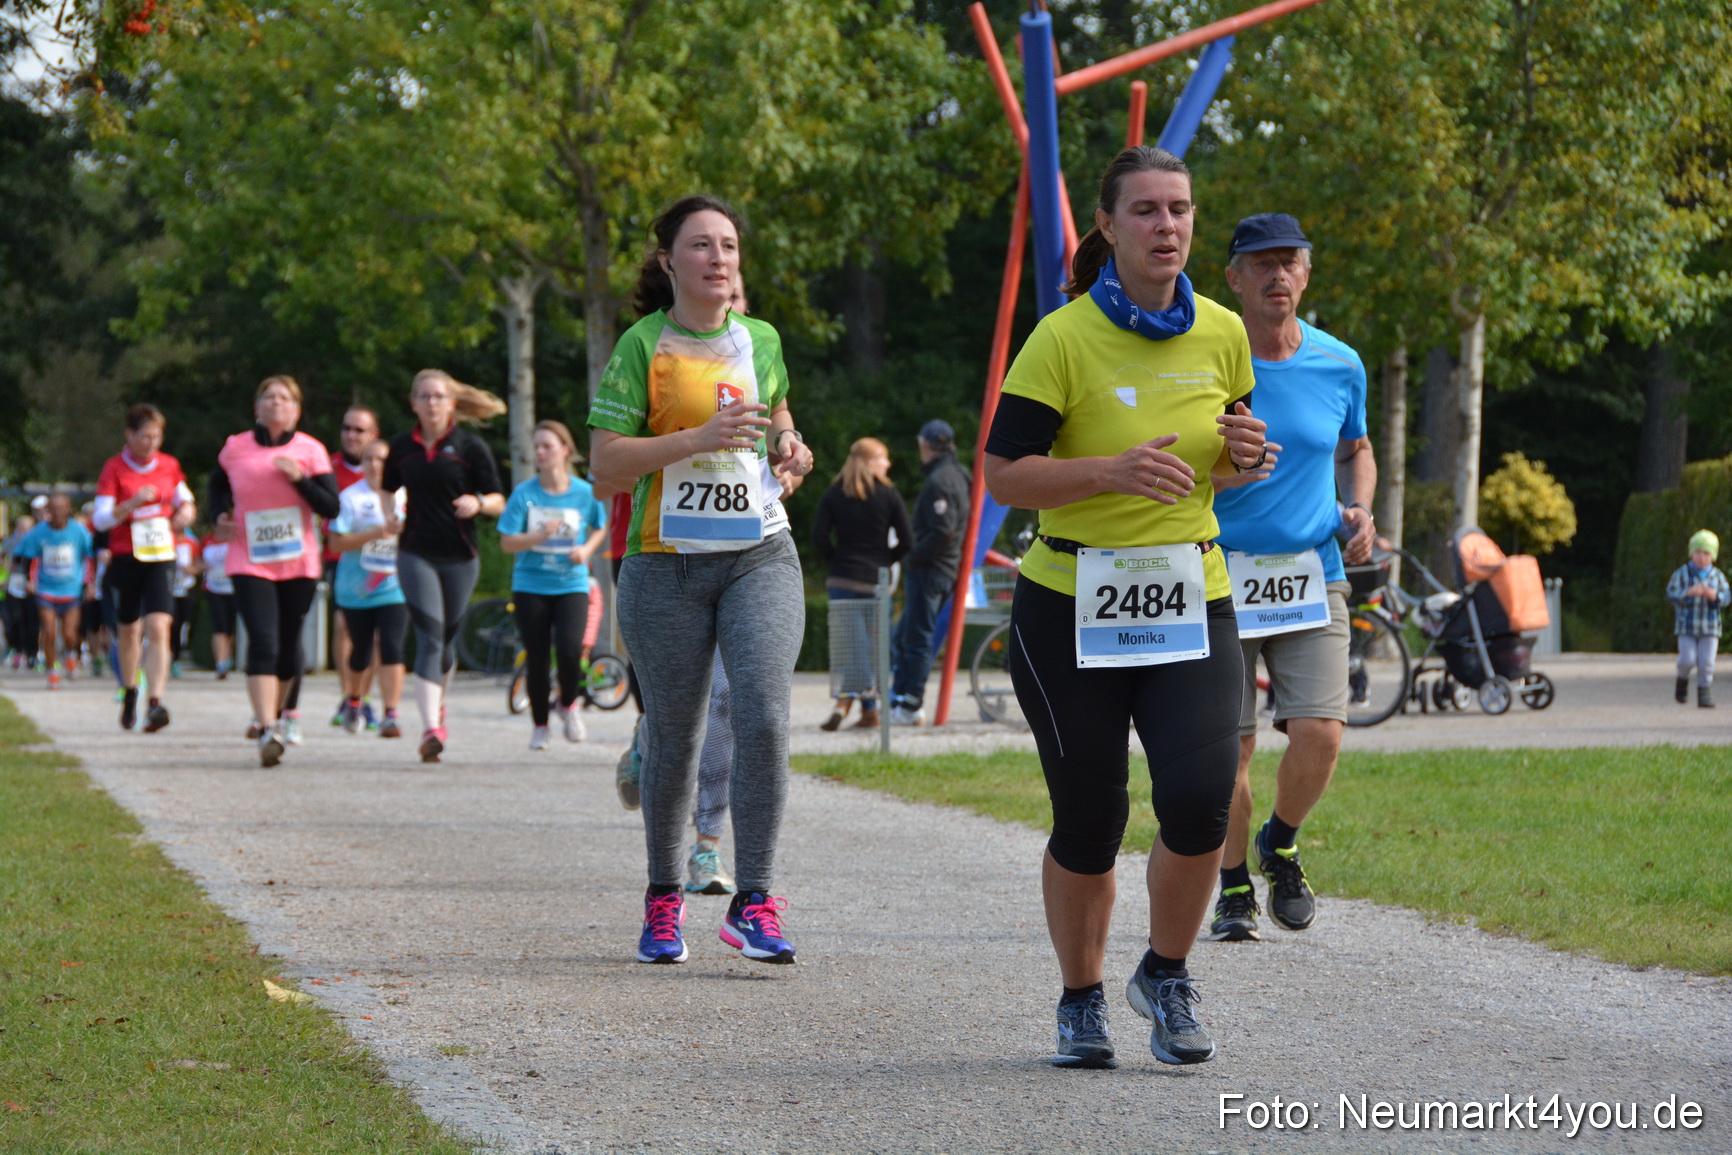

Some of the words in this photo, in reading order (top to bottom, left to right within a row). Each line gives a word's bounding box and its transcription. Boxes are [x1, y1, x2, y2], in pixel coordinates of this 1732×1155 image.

[703, 461, 736, 470] BOCK
[676, 481, 750, 512] 2788
[254, 522, 295, 542] 2084
[1127, 557, 1170, 569] BOCK
[1243, 574, 1310, 605] 2467
[1095, 582, 1187, 620] 2484
[1257, 611, 1304, 623] Wolfgang
[1117, 632, 1166, 646] Monika
